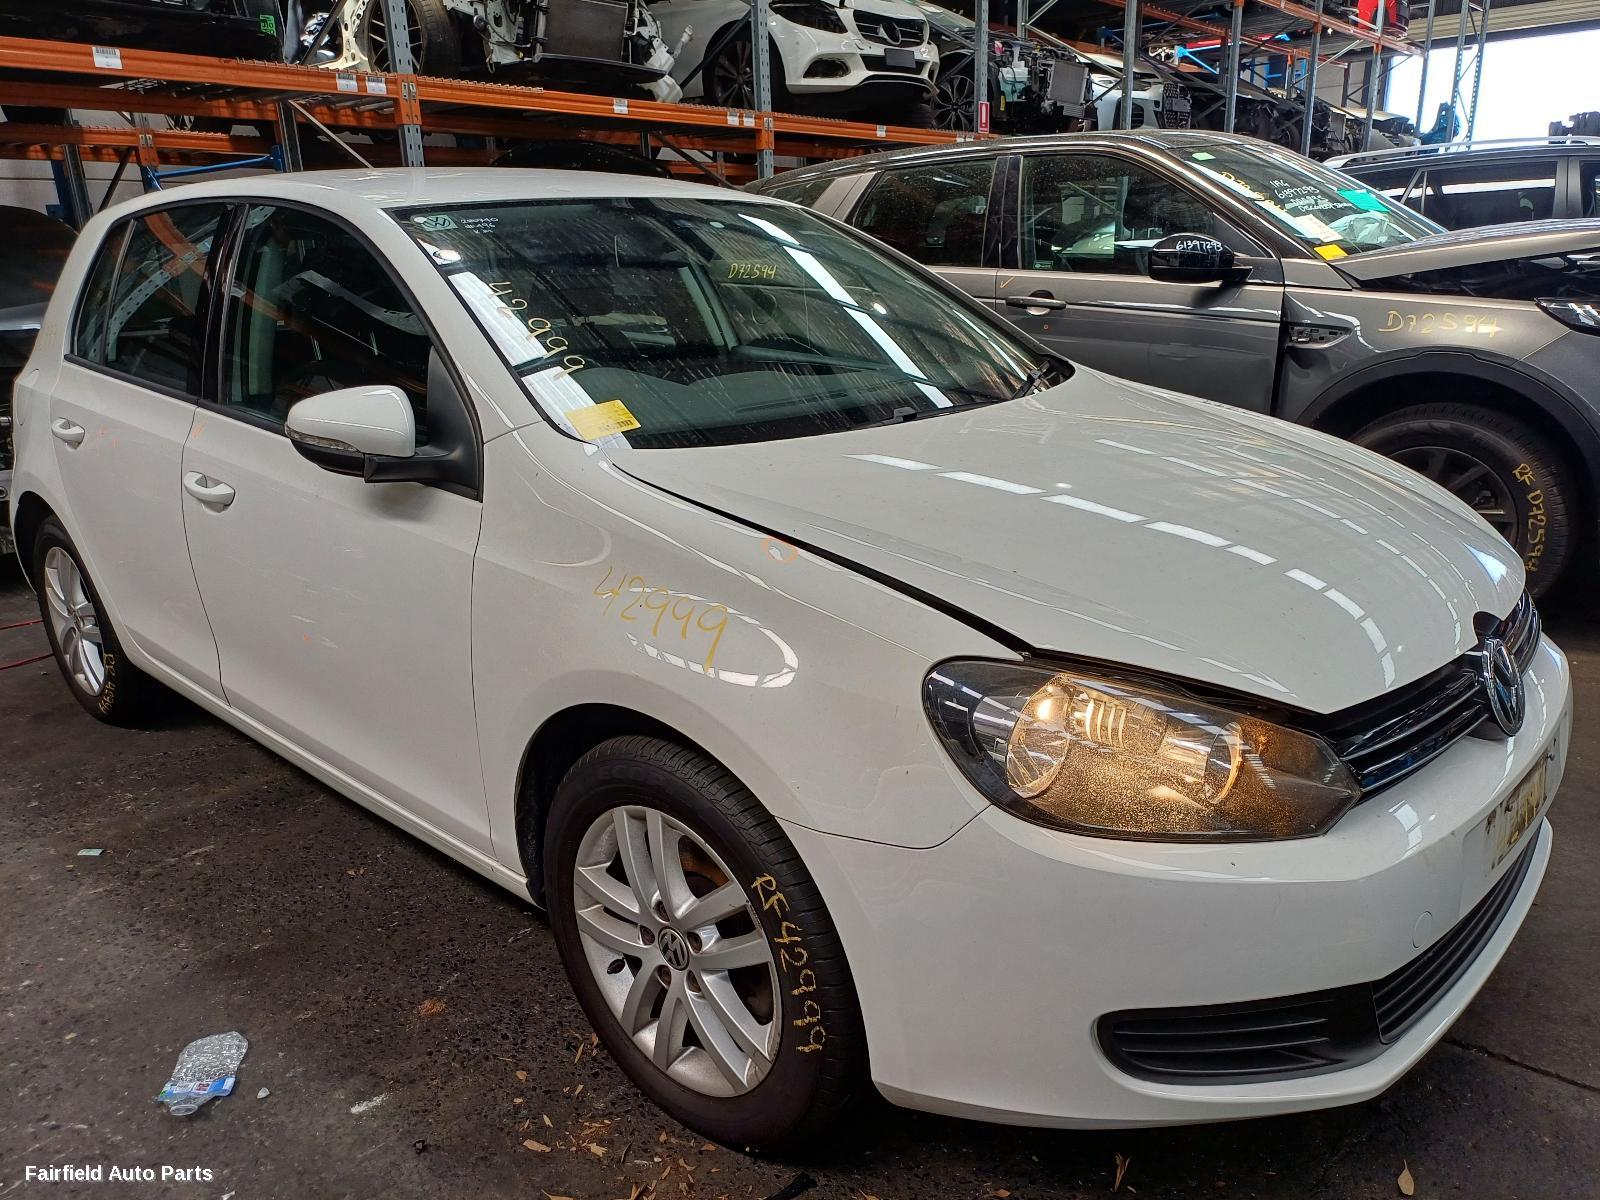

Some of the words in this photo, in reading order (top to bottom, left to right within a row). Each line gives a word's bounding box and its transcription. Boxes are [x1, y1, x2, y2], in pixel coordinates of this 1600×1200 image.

[1175, 240, 1223, 252] 61397293
[488, 281, 586, 381] 42999
[593, 566, 728, 673] 42999
